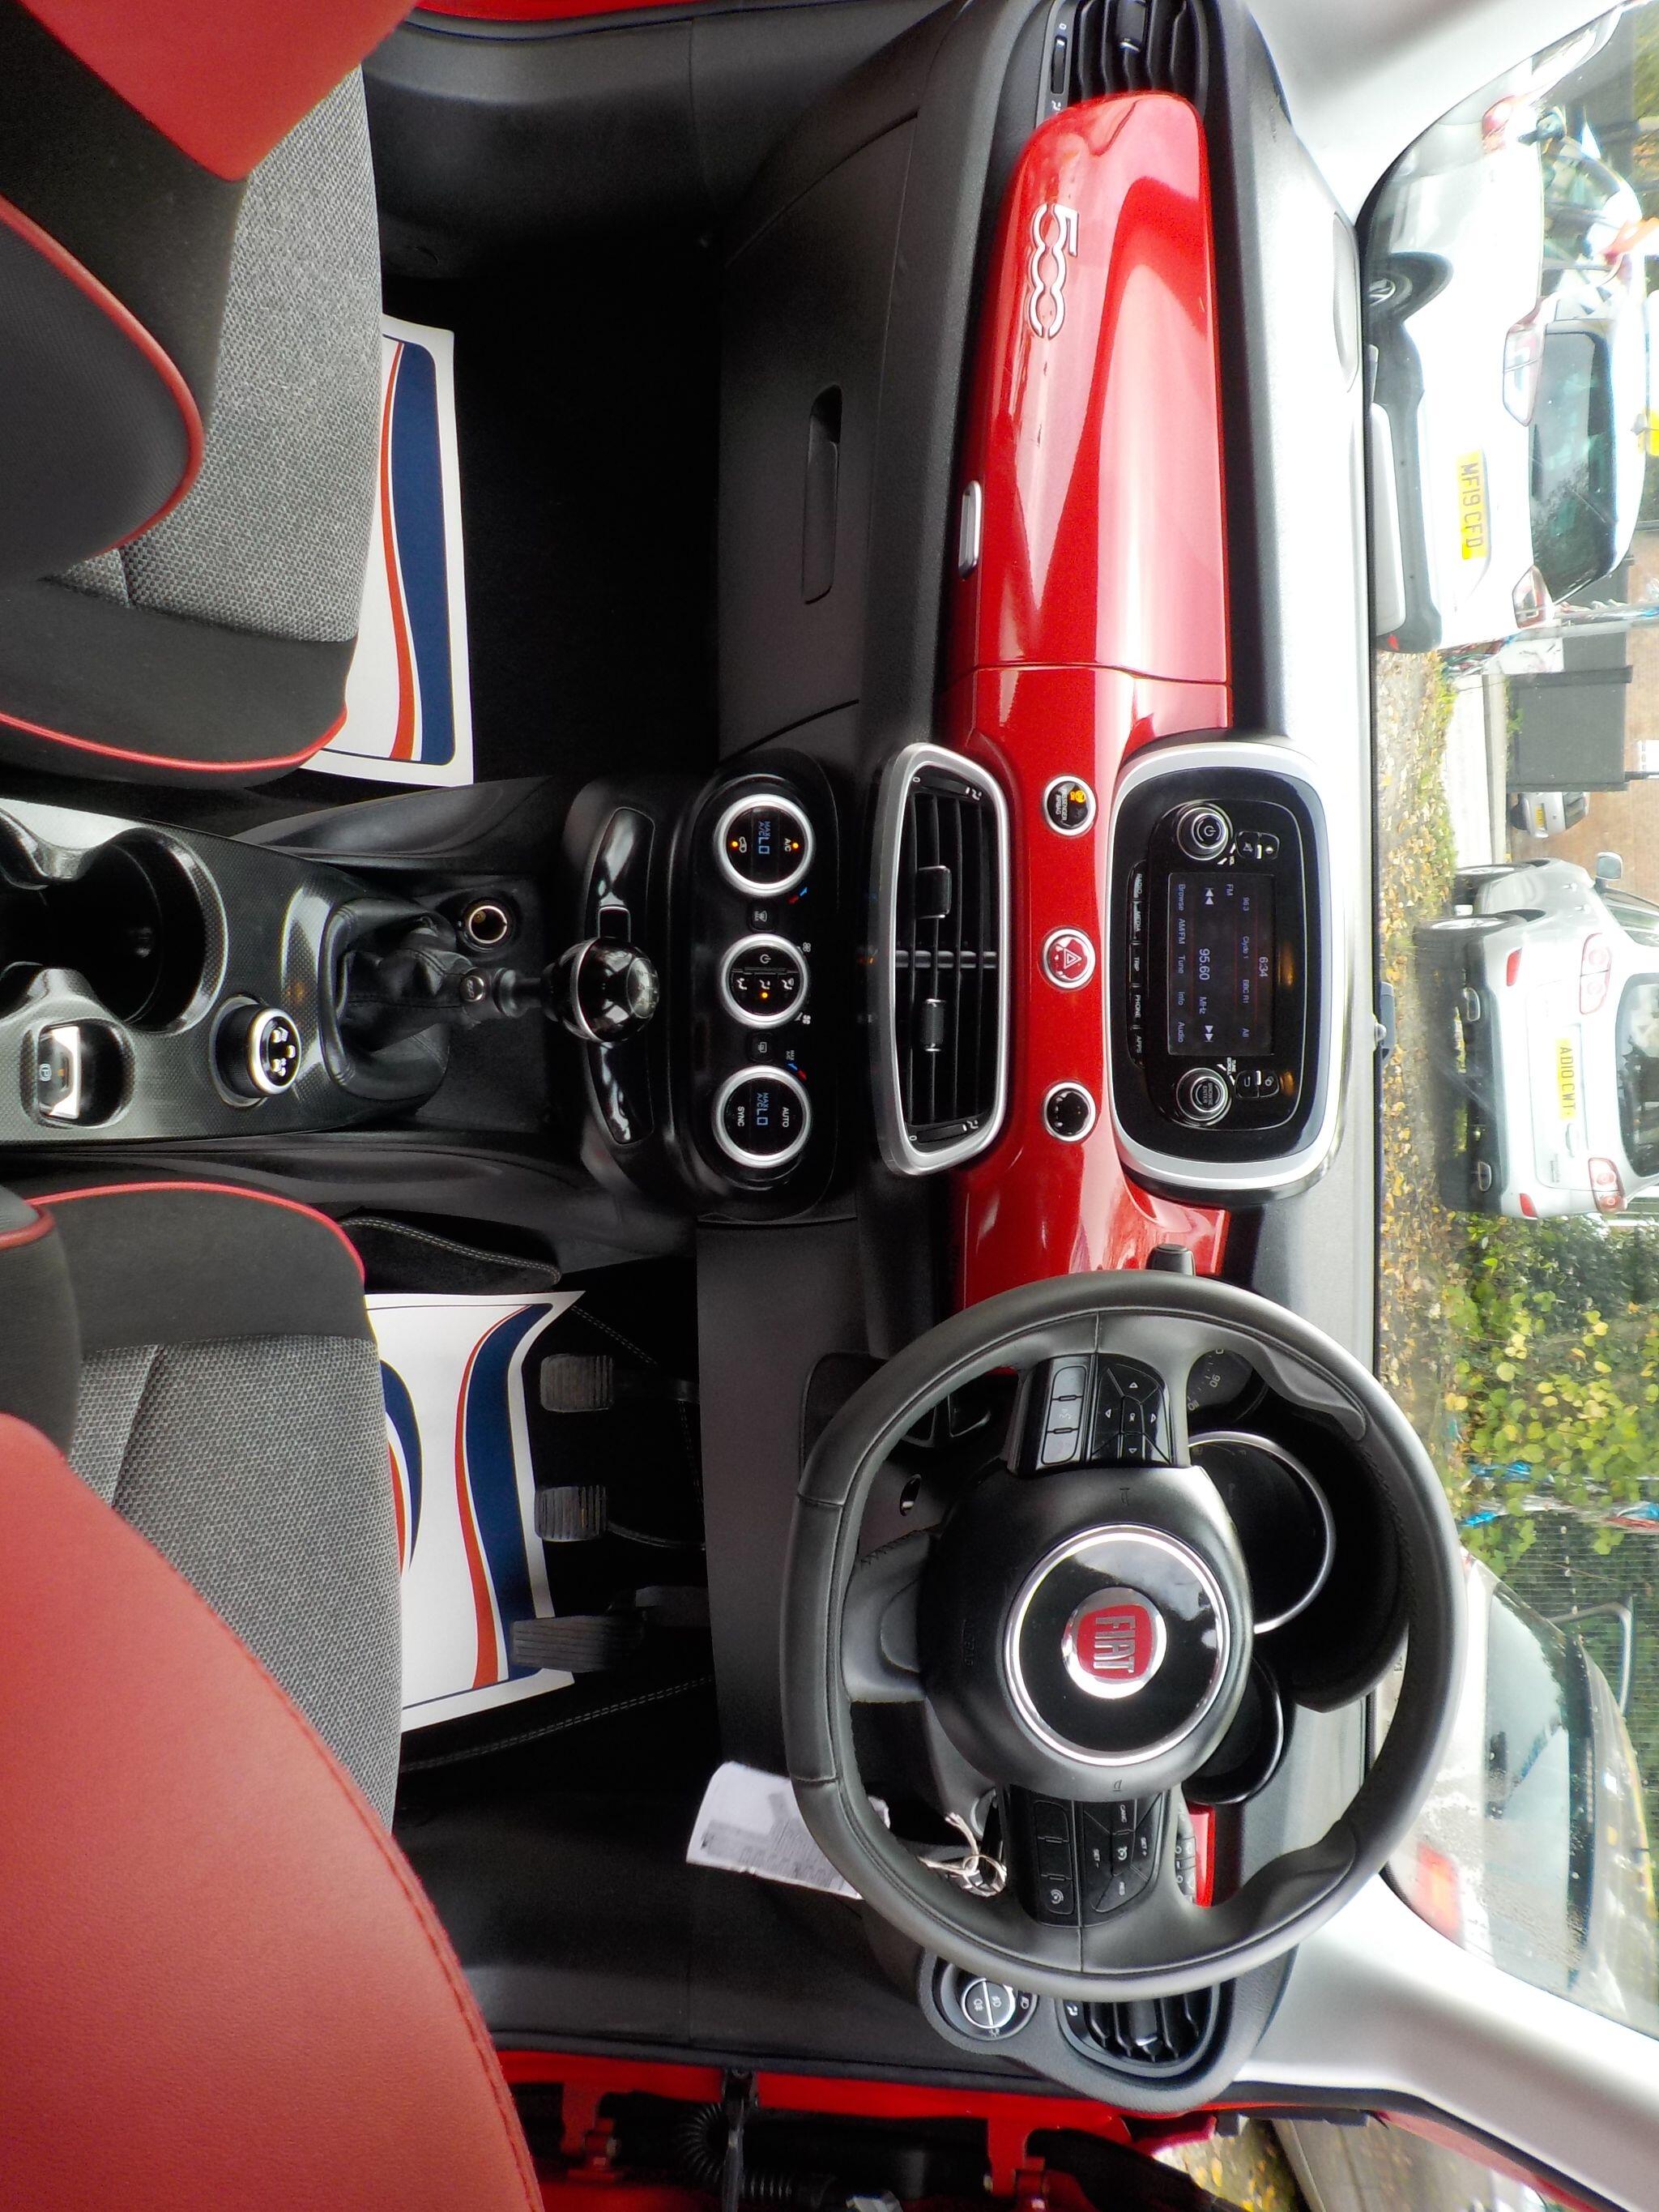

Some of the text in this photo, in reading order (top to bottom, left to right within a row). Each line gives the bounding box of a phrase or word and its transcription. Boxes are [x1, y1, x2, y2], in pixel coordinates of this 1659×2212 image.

[1028, 203, 1079, 340] 500
[1461, 463, 1481, 506] MF19
[1226, 884, 1233, 896] FM
[1259, 956, 1269, 977] 6:34
[1199, 948, 1210, 1014] 95.60 MHz
[1178, 1022, 1186, 1043] Audio
[1560, 1047, 1576, 1110] AD10 CWT
[737, 1106, 745, 1127] SYNC
[1209, 1373, 1221, 1387] 90
[1129, 1412, 1136, 1422] OK
[1094, 1616, 1136, 1673] FIAT
